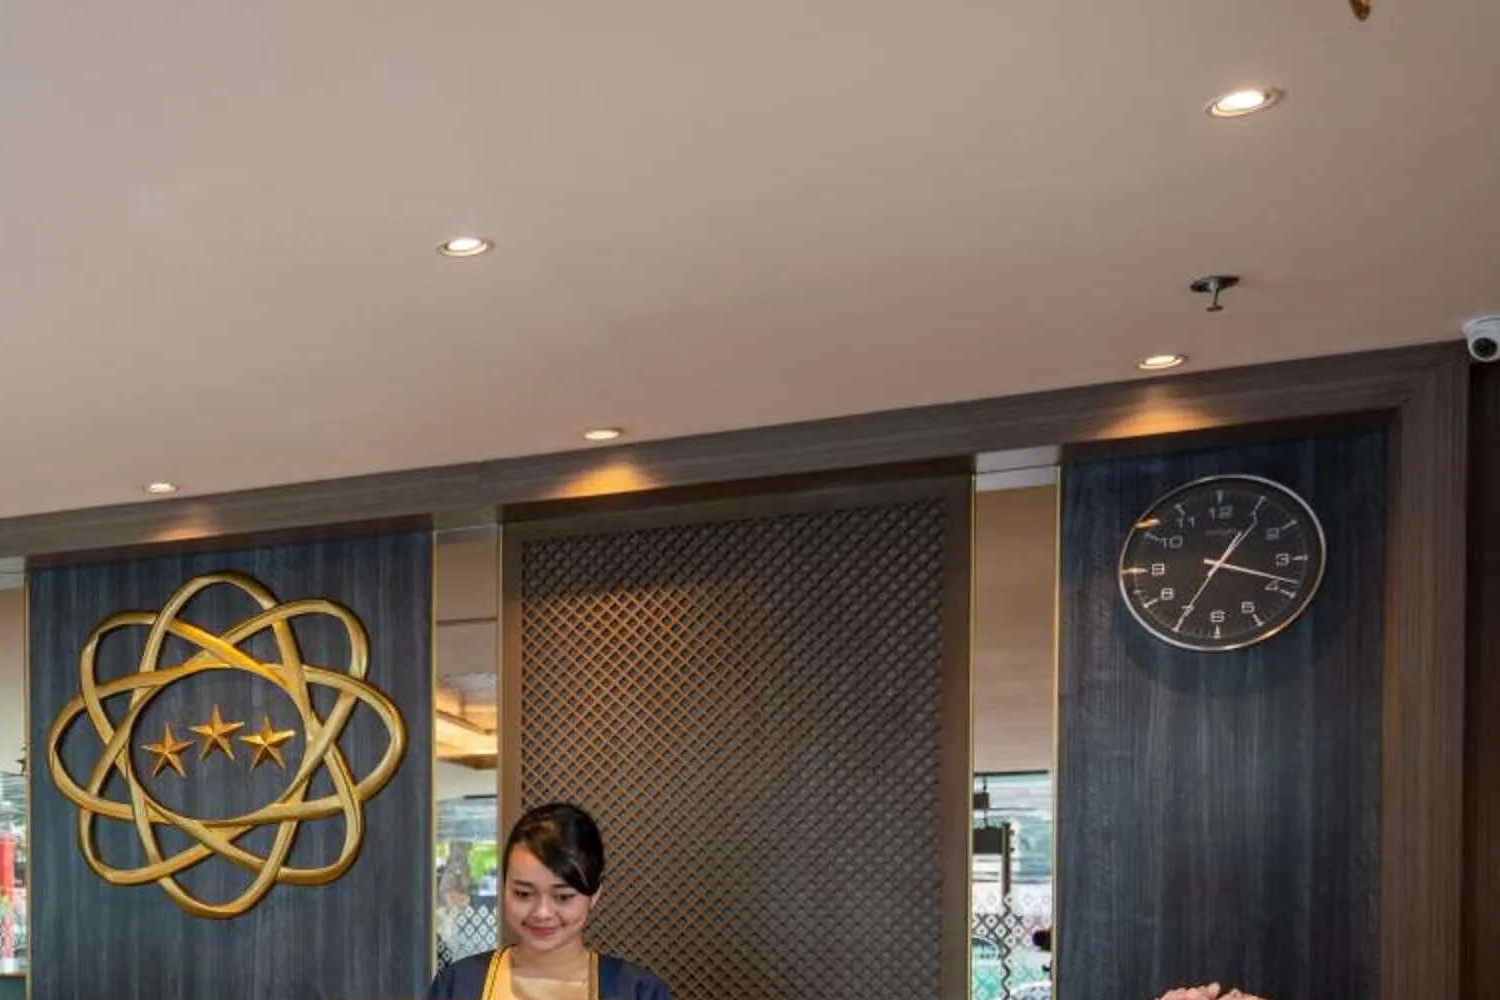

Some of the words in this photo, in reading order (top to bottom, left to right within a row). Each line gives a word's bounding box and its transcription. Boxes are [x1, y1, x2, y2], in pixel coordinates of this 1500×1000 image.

[1207, 505, 1233, 520] 12
[1176, 516, 1195, 529] 11
[1266, 527, 1280, 540] 2
[1160, 535, 1183, 551] 10
[1275, 553, 1290, 568] 3
[1151, 563, 1165, 576] 9
[1265, 578, 1279, 591] 4
[1160, 588, 1174, 600] 8
[1210, 610, 1225, 623] 6
